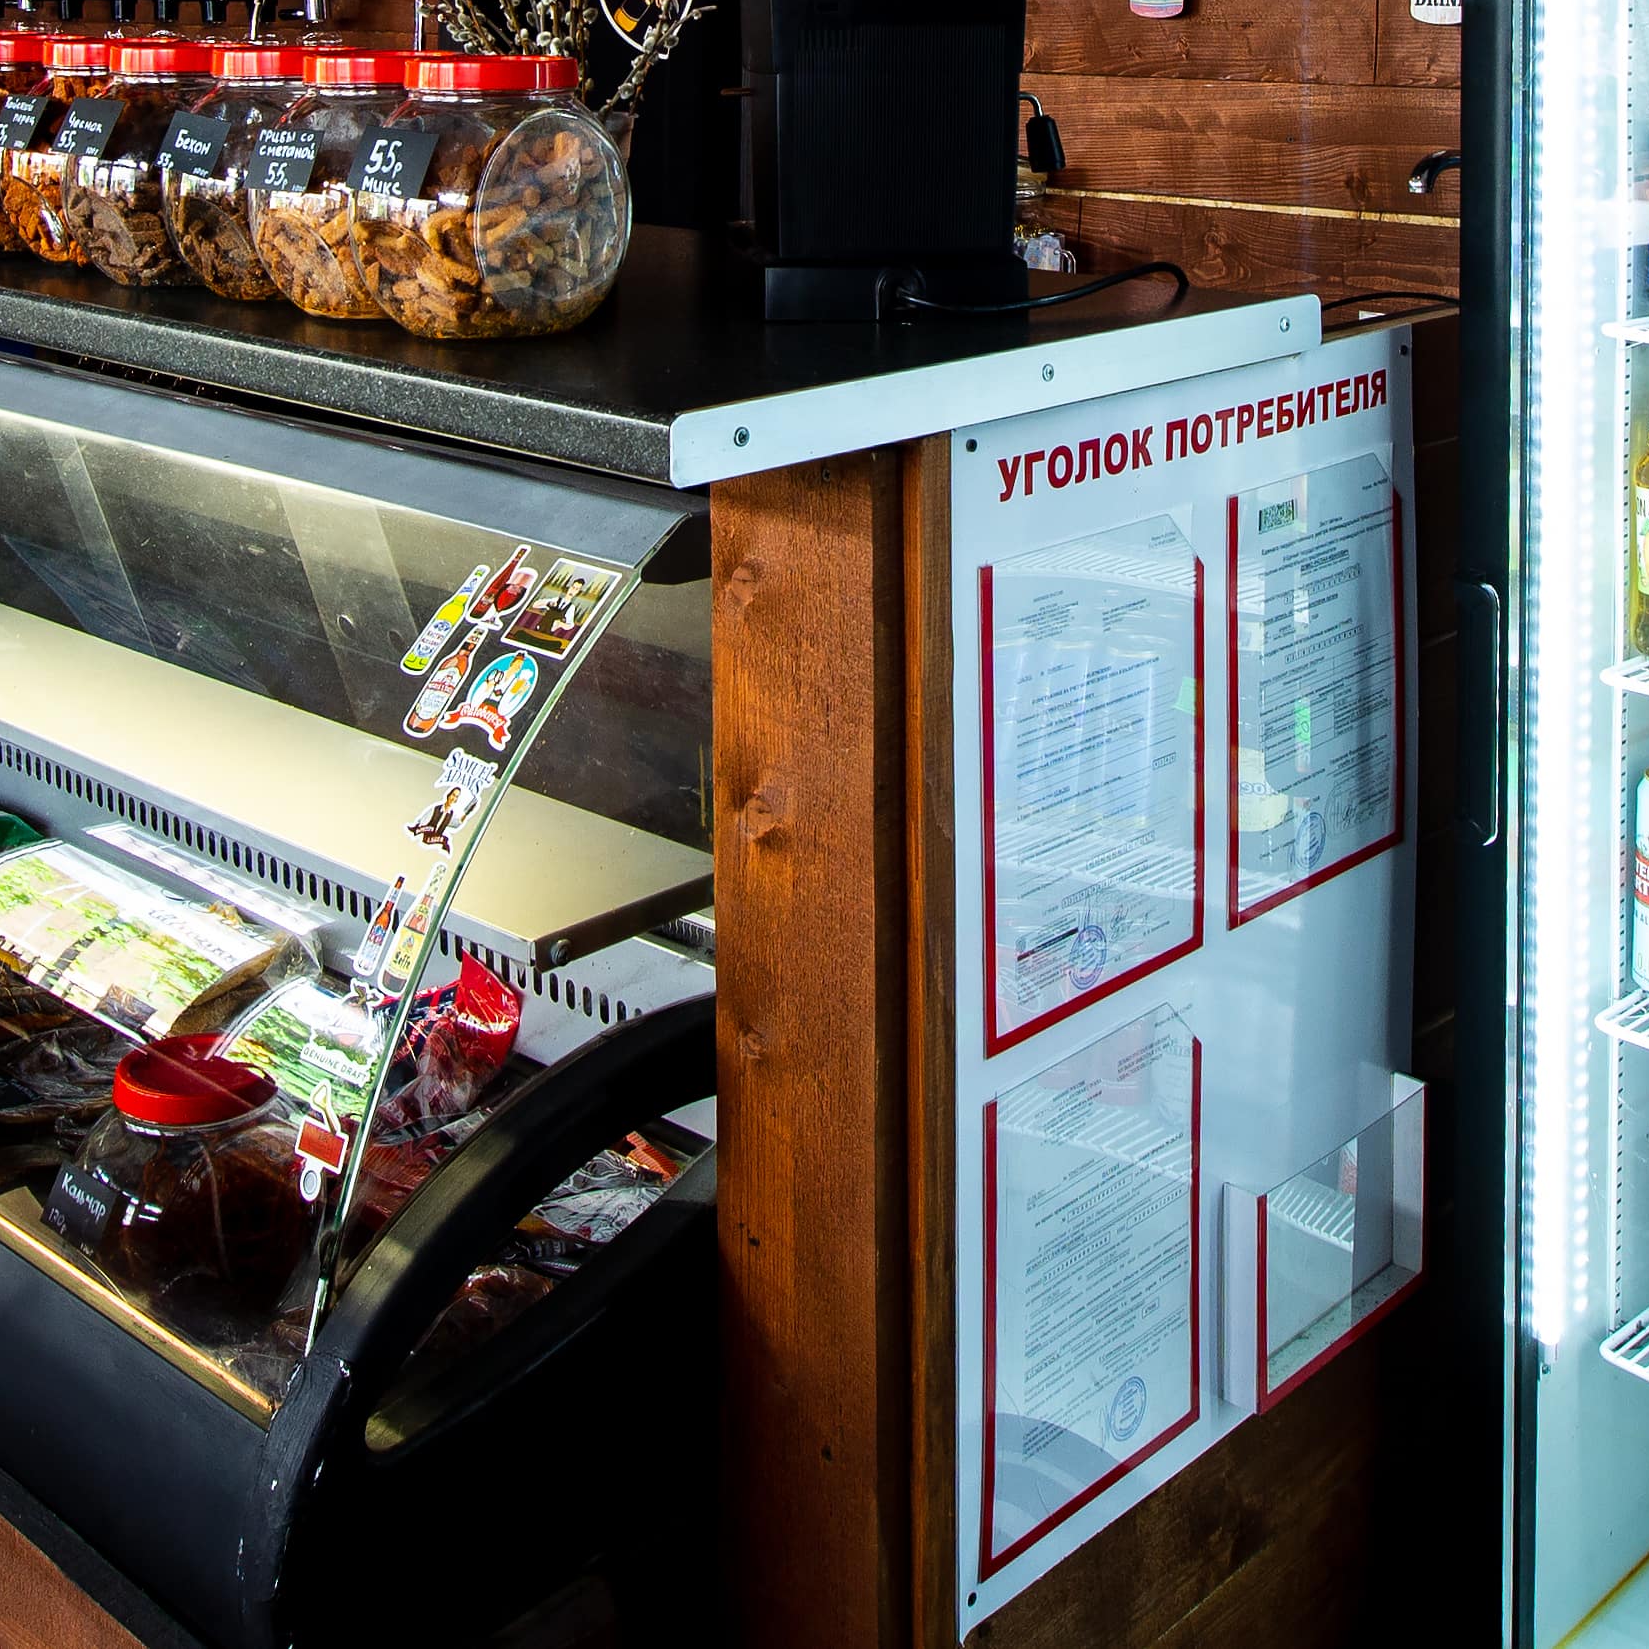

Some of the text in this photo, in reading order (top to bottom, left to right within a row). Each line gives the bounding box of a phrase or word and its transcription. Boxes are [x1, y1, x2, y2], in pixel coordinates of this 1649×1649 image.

[996, 368, 1388, 503] УГОЛОК ПОТРЕБИТЕЛЯ
[441, 770, 485, 796] ADAMS
[447, 750, 496, 785] SAMUEL
[302, 1045, 368, 1085] GENUINE DRAFT
